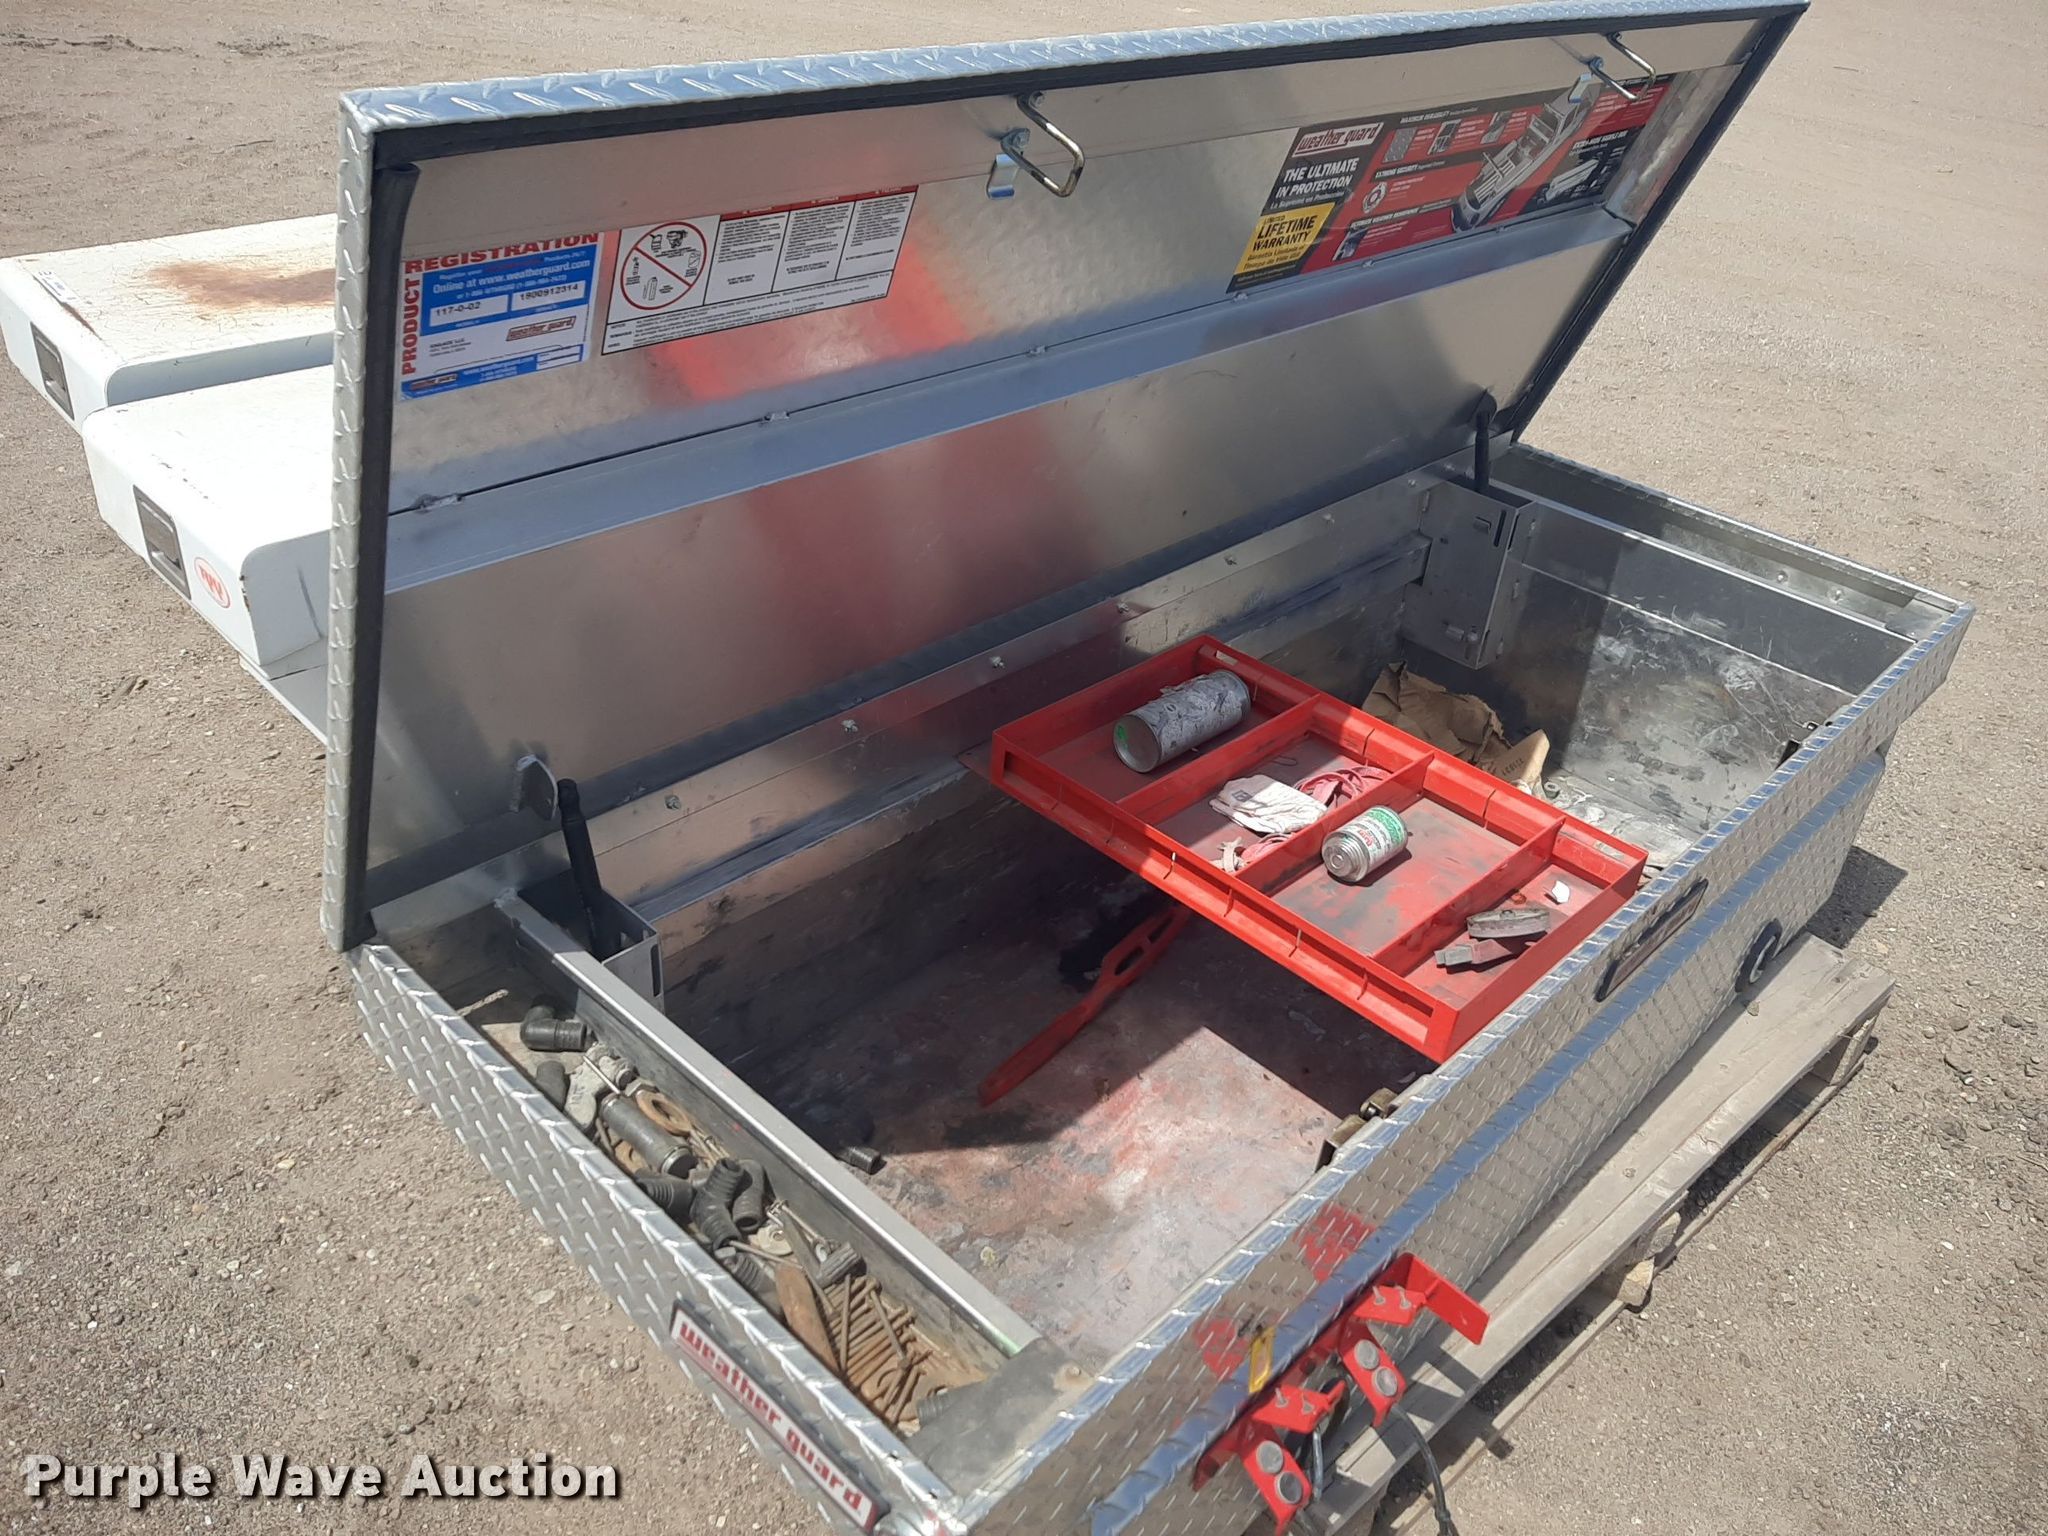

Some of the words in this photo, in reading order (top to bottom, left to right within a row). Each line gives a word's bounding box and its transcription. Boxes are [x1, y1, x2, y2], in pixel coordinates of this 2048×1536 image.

[1298, 130, 1345, 150] weather
[1345, 125, 1378, 146] guard
[1283, 168, 1306, 183] THE
[1307, 158, 1360, 179] ULTIMATE
[1276, 186, 1289, 199] IN
[1290, 175, 1353, 197] PROTECTION
[1257, 215, 1318, 239] LIFETIME
[405, 232, 599, 274] REGISTRATION
[1252, 231, 1311, 252] WARRANTY
[433, 280, 465, 294] Online
[467, 277, 478, 289] at
[478, 259, 590, 287] www.weatherguard.com
[436, 301, 481, 316] 117-0-02
[402, 278, 420, 375] PRODUCT
[679, 1321, 781, 1424] weather
[785, 1428, 865, 1510] guard
